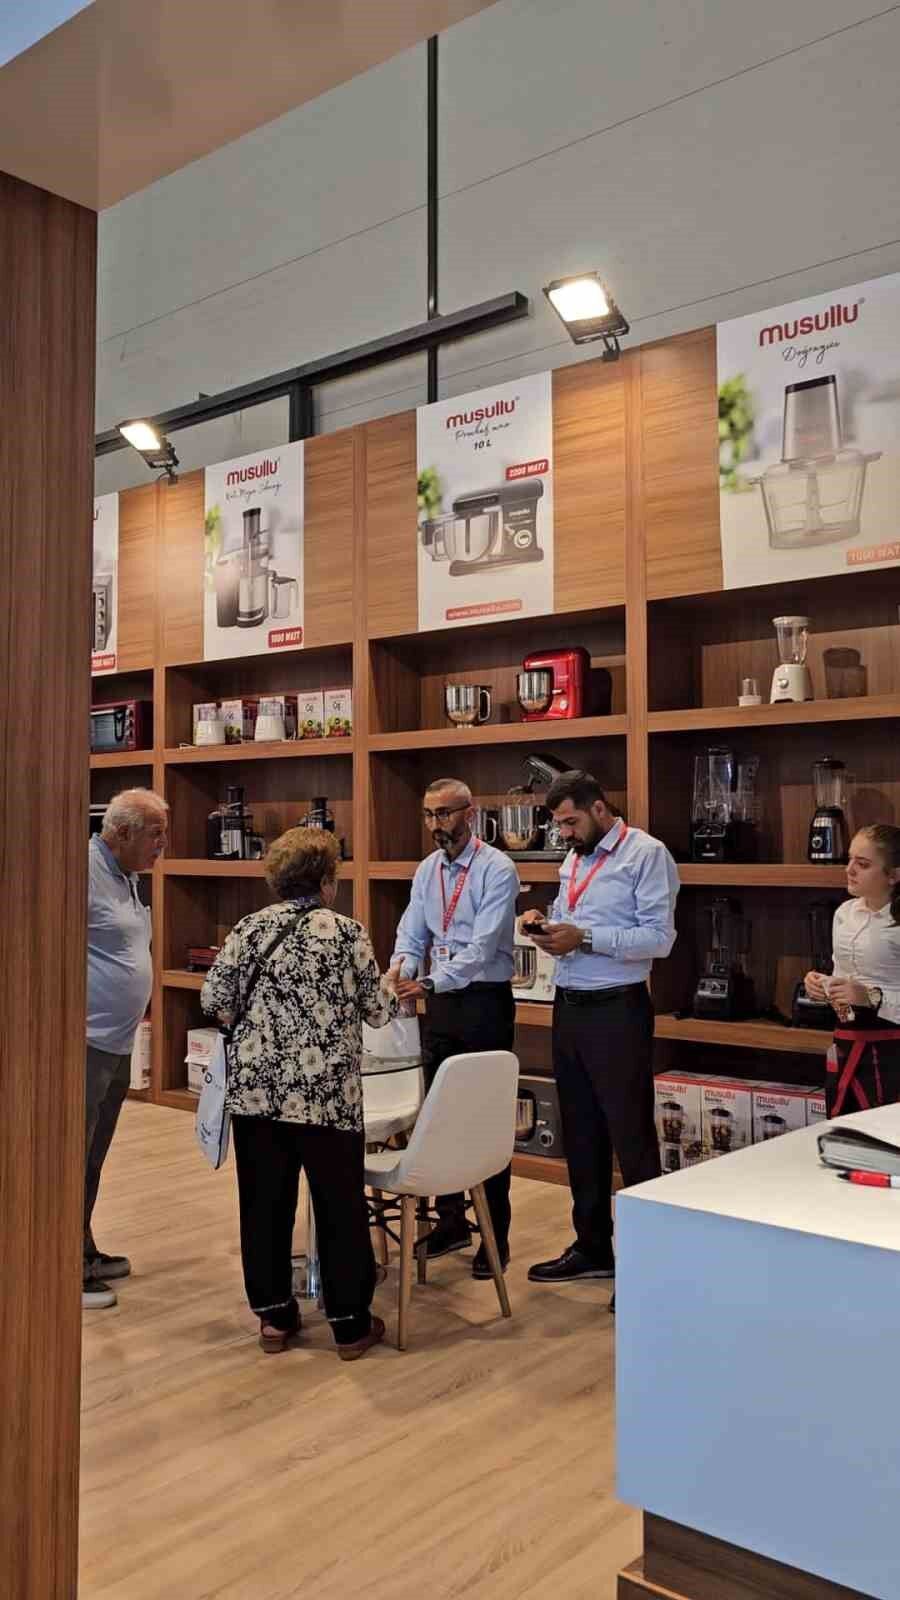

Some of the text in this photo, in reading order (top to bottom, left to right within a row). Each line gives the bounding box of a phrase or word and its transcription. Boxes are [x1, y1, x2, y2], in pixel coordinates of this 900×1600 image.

[759, 303, 859, 347] musullu
[446, 399, 515, 430] musullu
[226, 459, 278, 486] musullu
